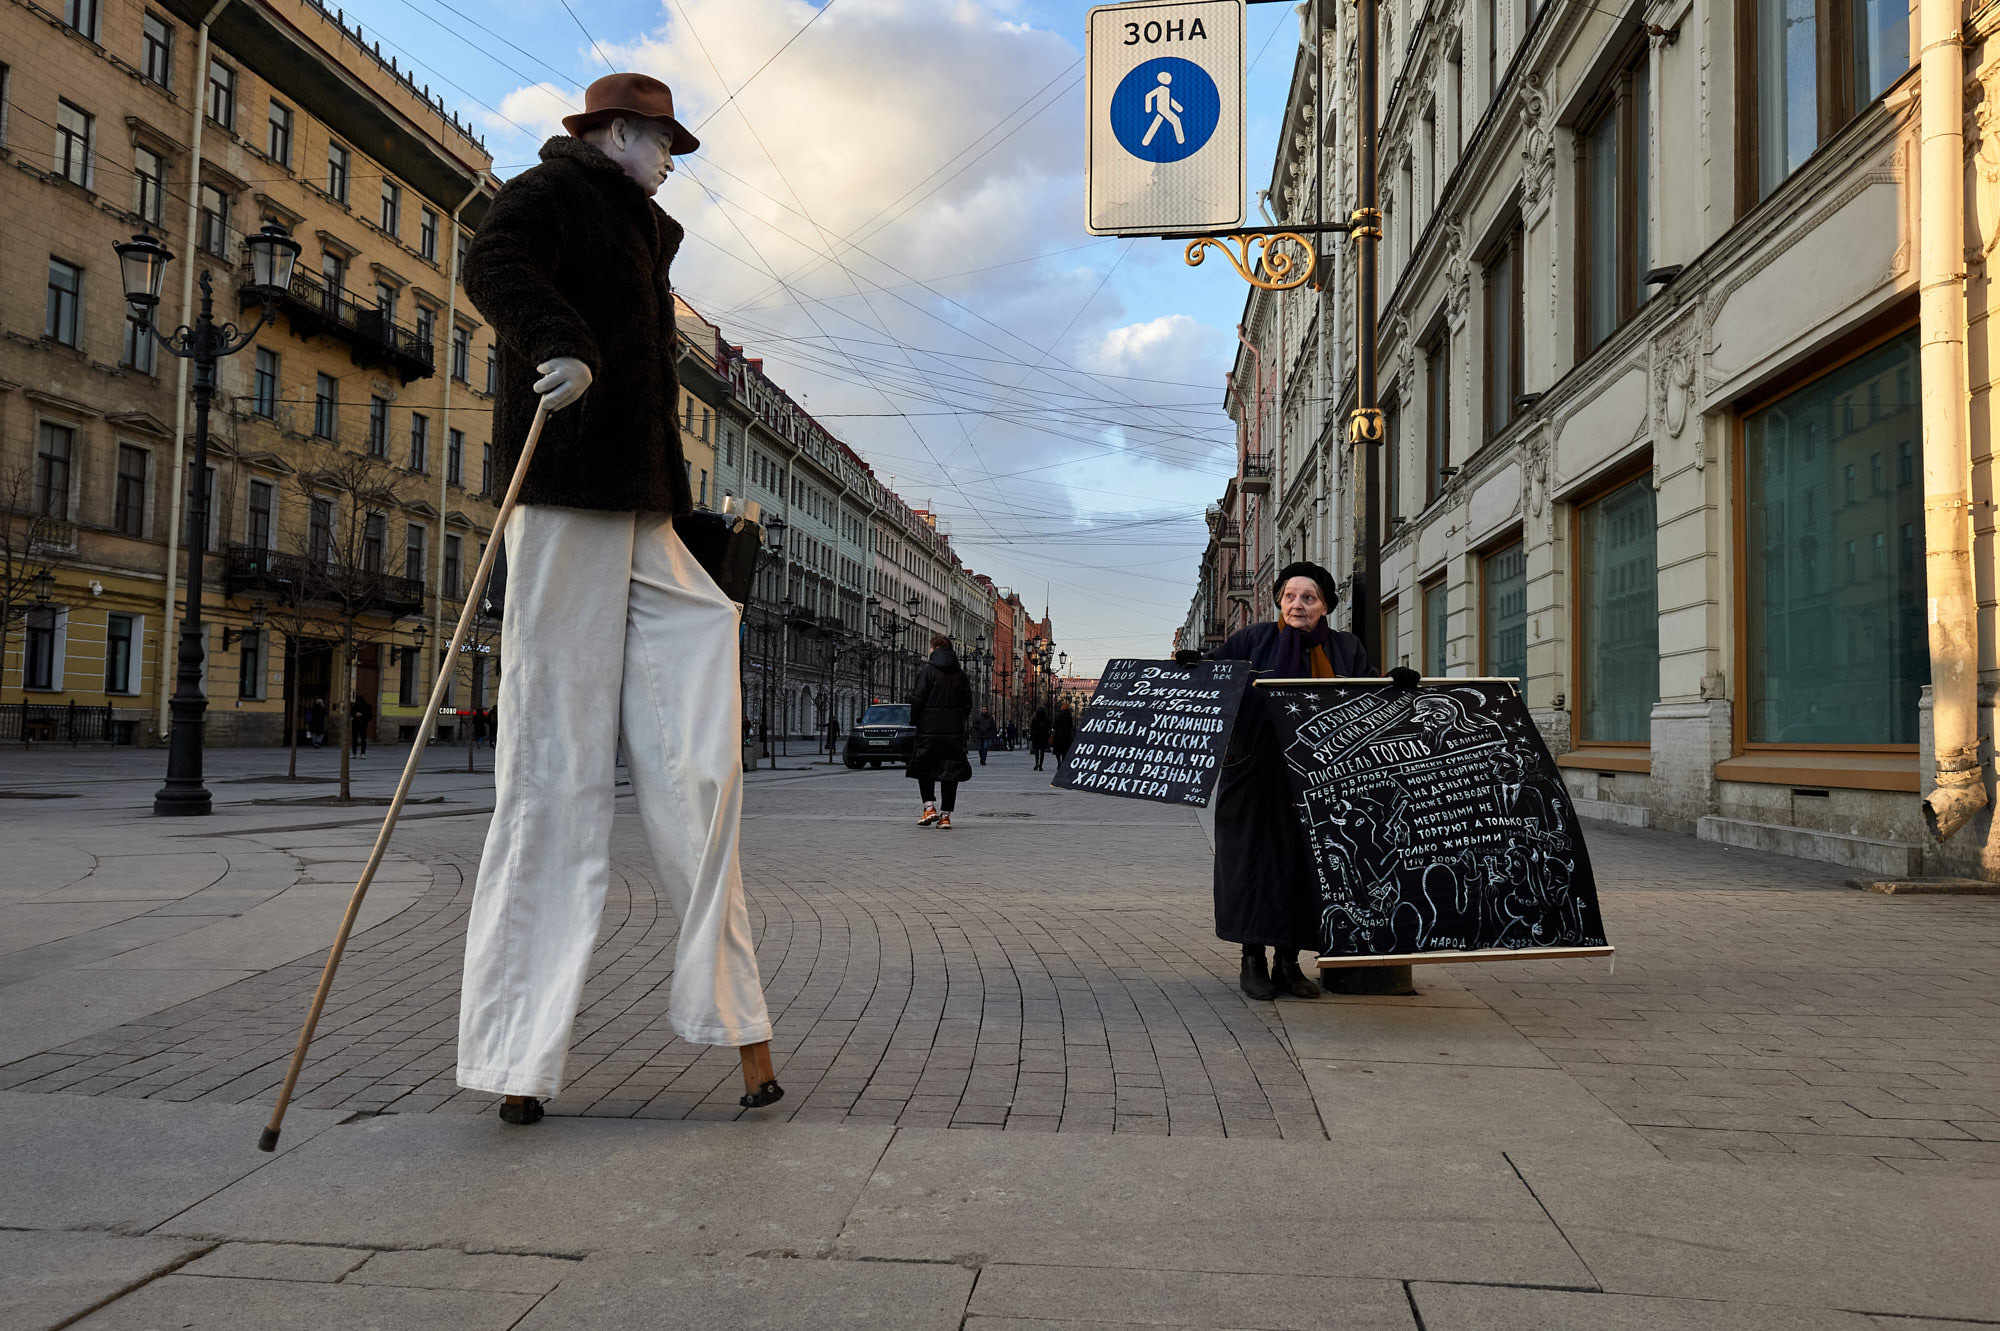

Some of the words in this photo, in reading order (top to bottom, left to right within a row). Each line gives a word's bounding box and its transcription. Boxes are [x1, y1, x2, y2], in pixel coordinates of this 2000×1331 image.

[1123, 18, 1207, 46] ЗОНА
[1108, 671, 1136, 680] 1809
[1141, 667, 1191, 681] День
[1128, 680, 1222, 699] Рождения
[1091, 695, 1146, 708] Великого
[1166, 699, 1222, 715] Гоголя
[1307, 697, 1378, 738] РАЗБУДИЛИ
[1081, 719, 1136, 736] ЛЮБИЛ
[1150, 713, 1224, 733] УКРАИНЦЕВ
[1075, 743, 1095, 755] НО
[1190, 754, 1215, 769] ЧТО
[1313, 723, 1364, 764] РУССКИЙ
[1307, 755, 1372, 786] ПИСАТЕЛЬ
[1369, 740, 1431, 764] ГОГОЛЬ
[1445, 729, 1492, 750] ВЕЛИКИЙ
[1070, 757, 1101, 772] ОНИ
[1104, 760, 1135, 775] ДВА
[1140, 764, 1204, 785] РАЗНЫХ
[1407, 772, 1437, 786] МОЧАТ
[1448, 761, 1489, 778] СОРТИРАХ
[1072, 772, 1169, 797] ХАРАКТЕРА
[1309, 784, 1335, 801] ТЕБЕ
[1357, 770, 1388, 783] ГРОБУ
[1325, 795, 1337, 805] НЕ
[1341, 780, 1396, 797] ПРИСНИТСЯ
[1413, 788, 1428, 799] НА
[1431, 777, 1471, 796] ДЕНЬГИ
[1409, 798, 1443, 813] ТАКЖЕ
[1445, 785, 1491, 803] РАЗВОДЯТ
[1413, 806, 1474, 827] МЕРТВЫМИ
[1478, 802, 1493, 812] НЕ
[1475, 819, 1484, 827] А
[1485, 817, 1522, 827] ТОЛЬКО
[1309, 829, 1323, 864] НИЩИХ
[1397, 843, 1438, 858] ТОЛЬКО
[1443, 833, 1502, 849] ЖИВЫМИ
[1344, 902, 1390, 928] ЗАЧИЩАЮТ
[1429, 937, 1467, 949] НАРОД
